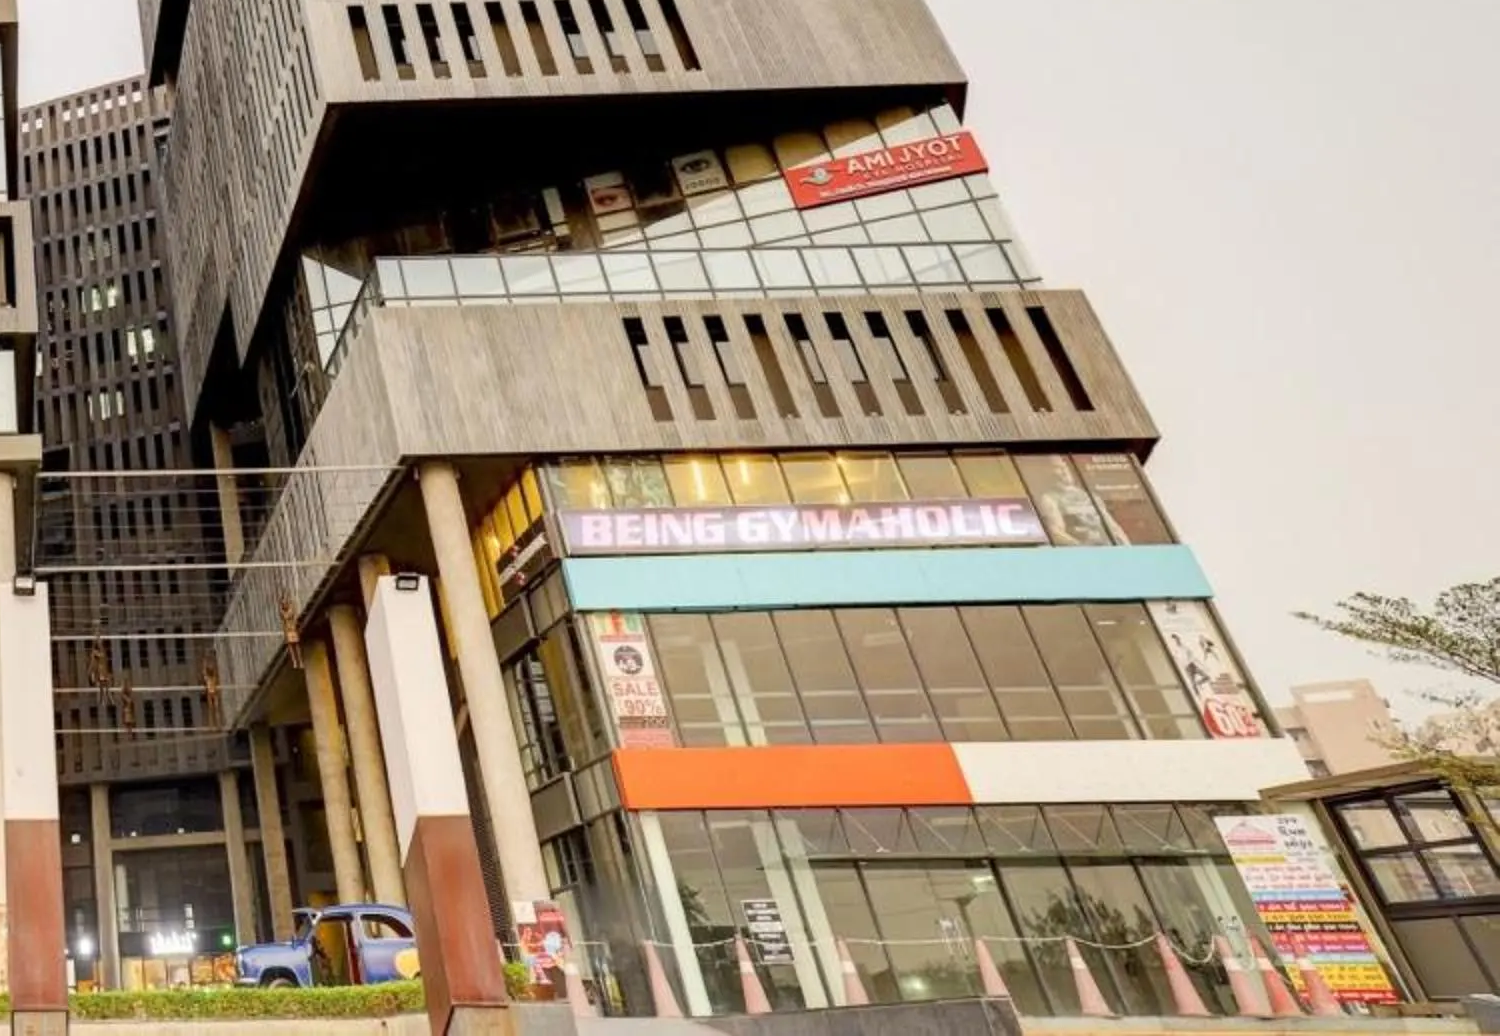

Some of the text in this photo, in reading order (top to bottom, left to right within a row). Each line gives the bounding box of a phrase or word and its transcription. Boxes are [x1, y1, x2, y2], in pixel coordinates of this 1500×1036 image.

[847, 136, 962, 175] AMI JYOT
[581, 503, 1030, 548] BEING GYMAHOLIC
[612, 681, 659, 698] SALE
